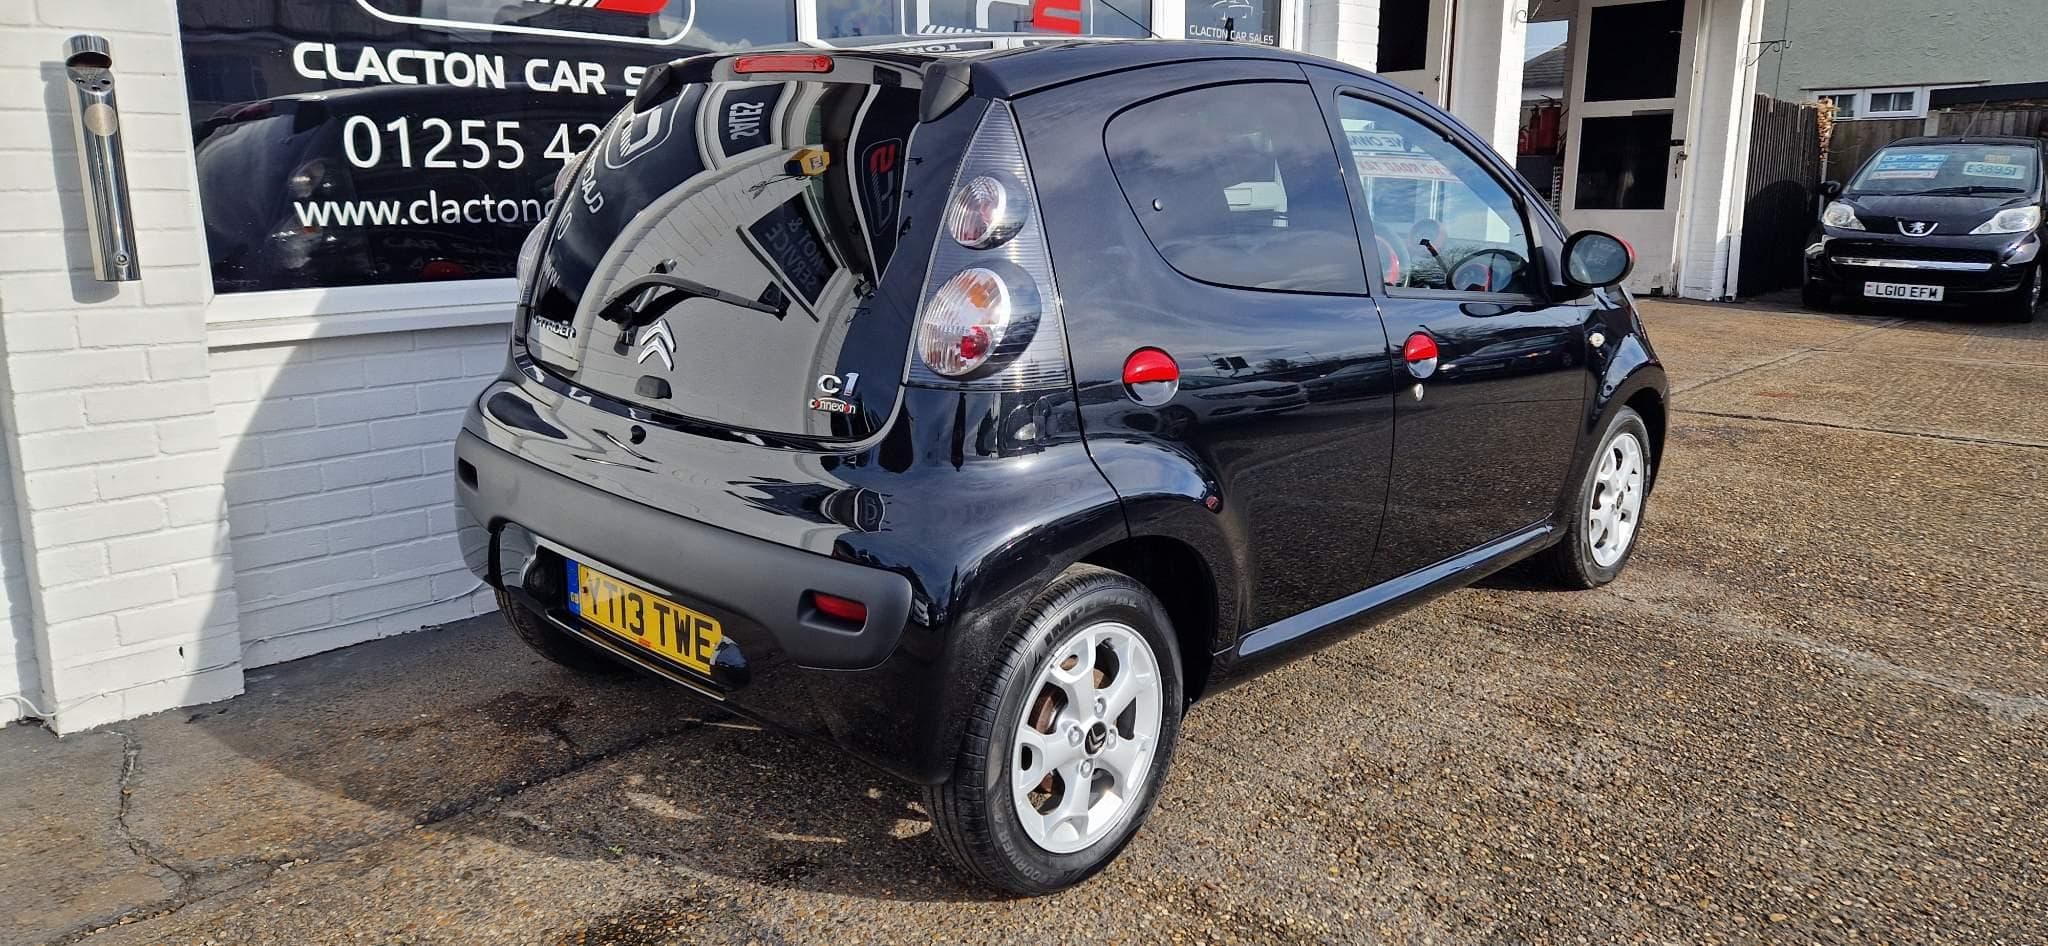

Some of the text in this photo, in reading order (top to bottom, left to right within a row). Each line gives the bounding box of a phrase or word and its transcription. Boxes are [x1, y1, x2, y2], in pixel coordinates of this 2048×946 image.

[1189, 25, 1274, 45] CLACTON CAR SALES
[293, 42, 506, 88] CLACTON
[525, 58, 607, 95] CAR
[343, 114, 525, 169] 01255
[1875, 283, 1938, 299] LG10 EFM
[817, 372, 859, 397] C1
[588, 576, 713, 665] YT13 TWE
